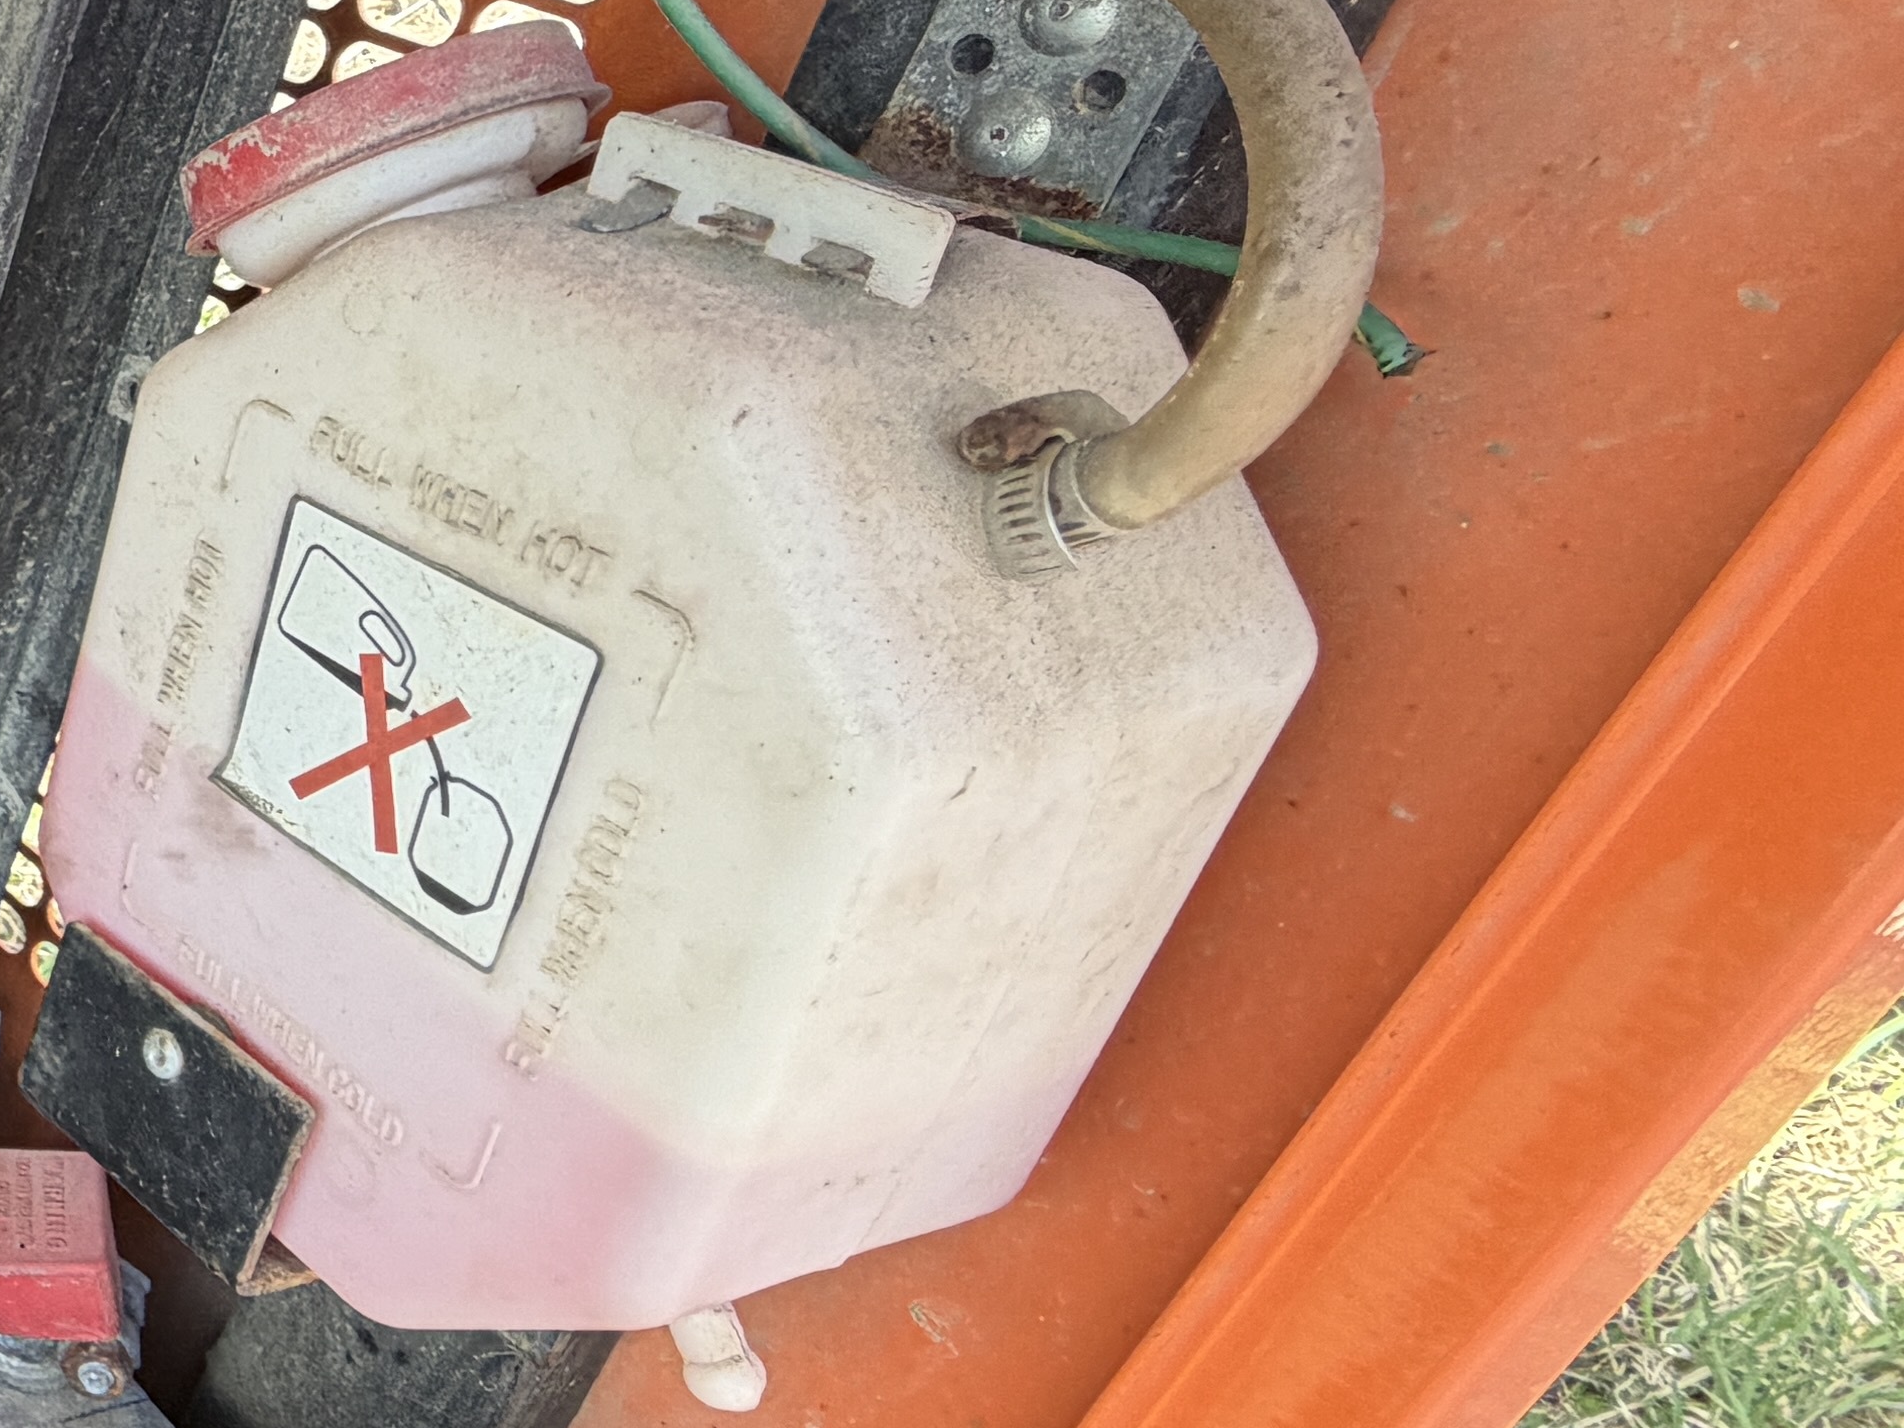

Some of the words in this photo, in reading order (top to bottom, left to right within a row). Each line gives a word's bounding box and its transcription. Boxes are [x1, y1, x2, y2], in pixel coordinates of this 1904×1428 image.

[309, 415, 393, 488] FULL
[410, 463, 514, 545] WHEN
[518, 521, 613, 588] HOT
